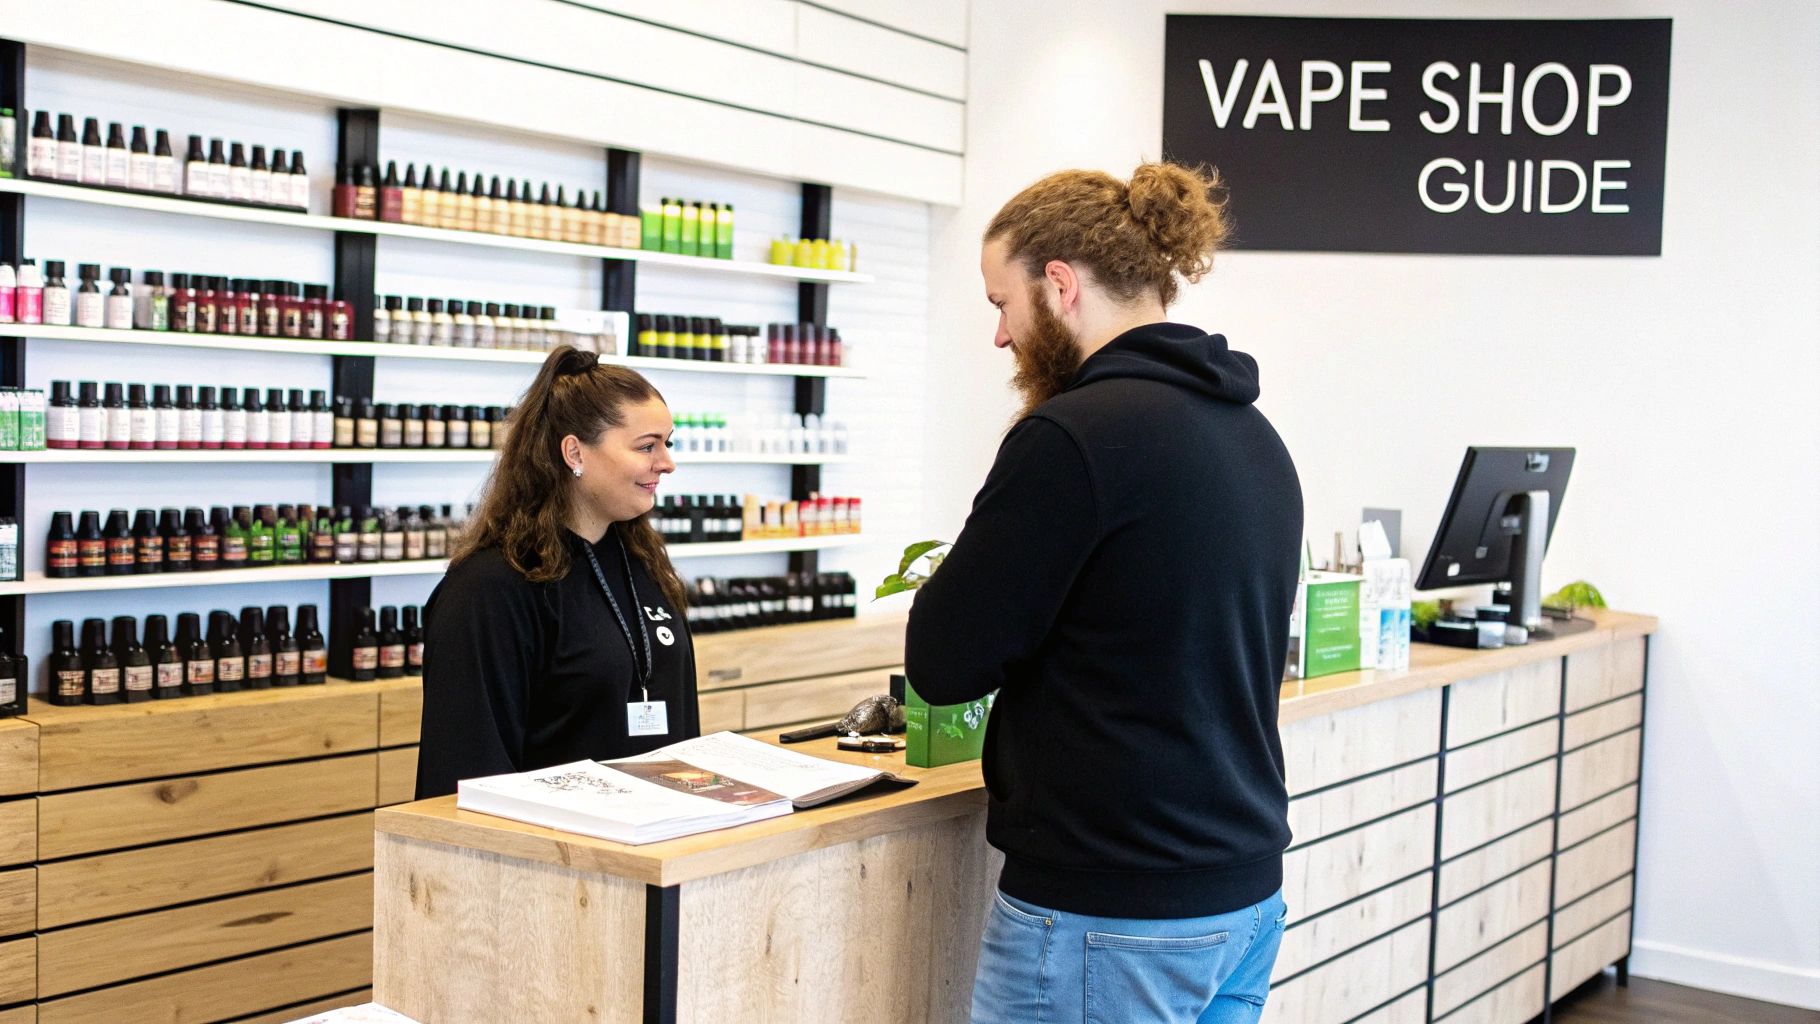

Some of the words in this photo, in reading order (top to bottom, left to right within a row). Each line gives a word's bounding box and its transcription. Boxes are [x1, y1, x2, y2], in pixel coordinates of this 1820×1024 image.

[1198, 58, 1392, 132] VAPE
[1419, 61, 1633, 136] SHOP
[1417, 157, 1632, 214] GUIDE
